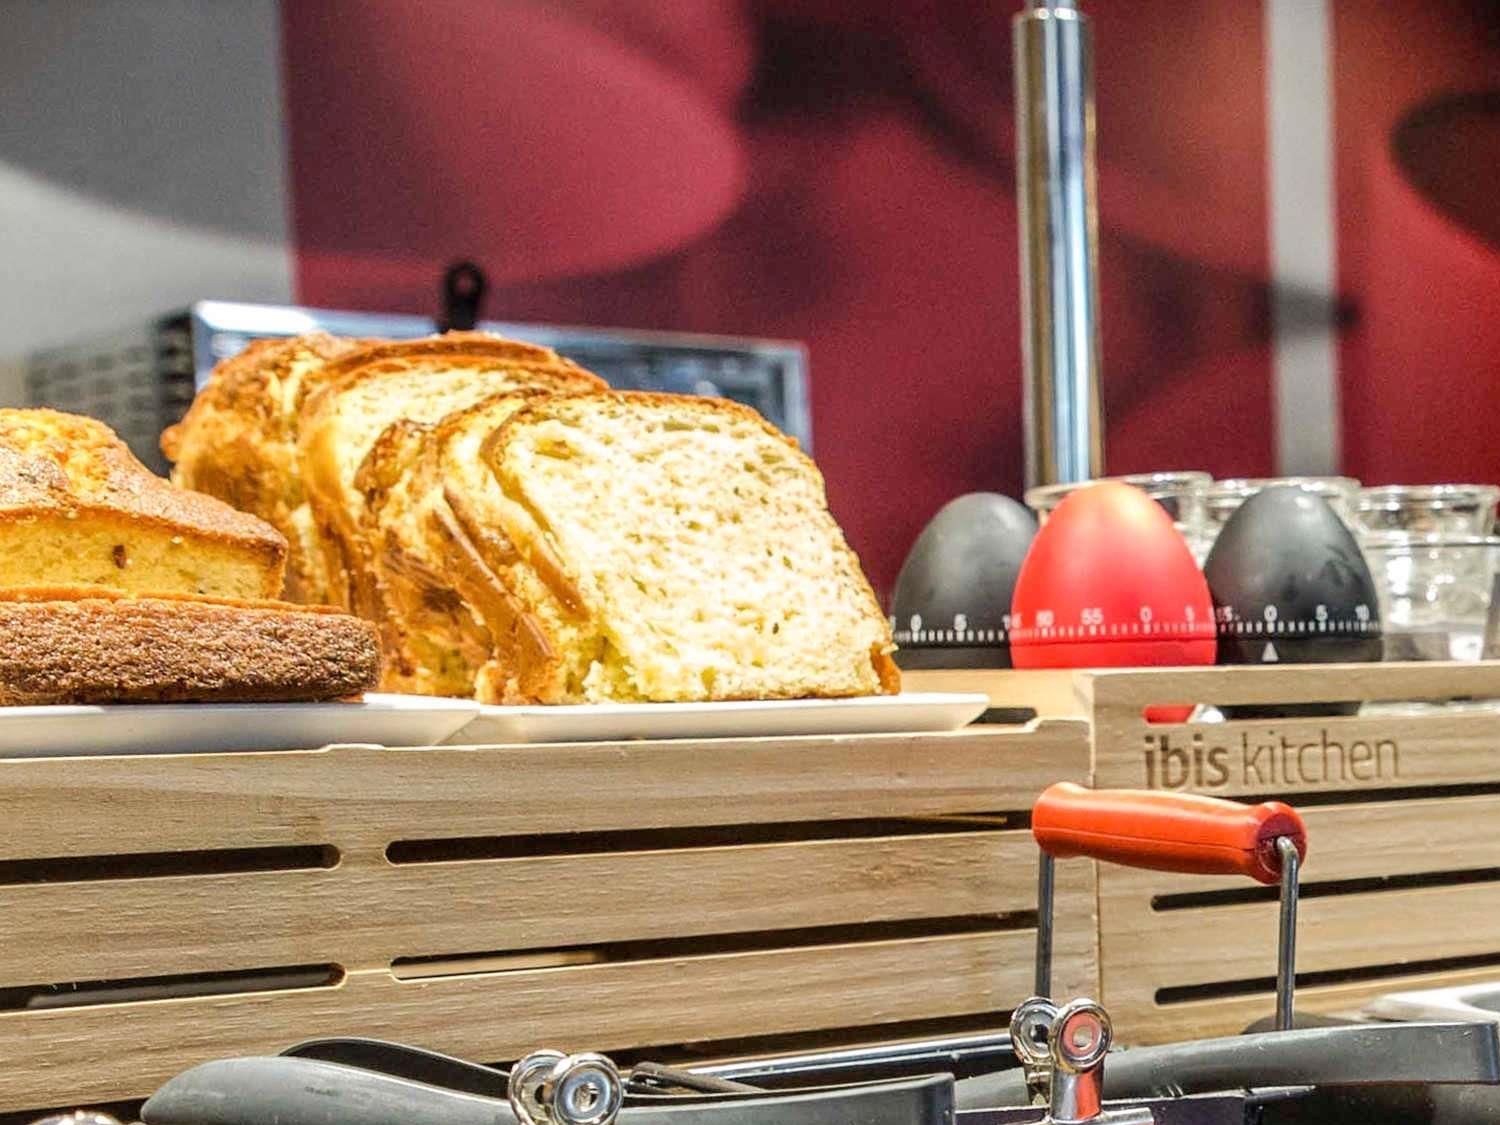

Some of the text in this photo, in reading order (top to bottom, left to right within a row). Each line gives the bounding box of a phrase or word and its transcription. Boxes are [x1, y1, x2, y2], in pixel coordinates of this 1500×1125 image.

[1264, 604, 1277, 622] 0
[1144, 731, 1400, 789] ibis kitchen
